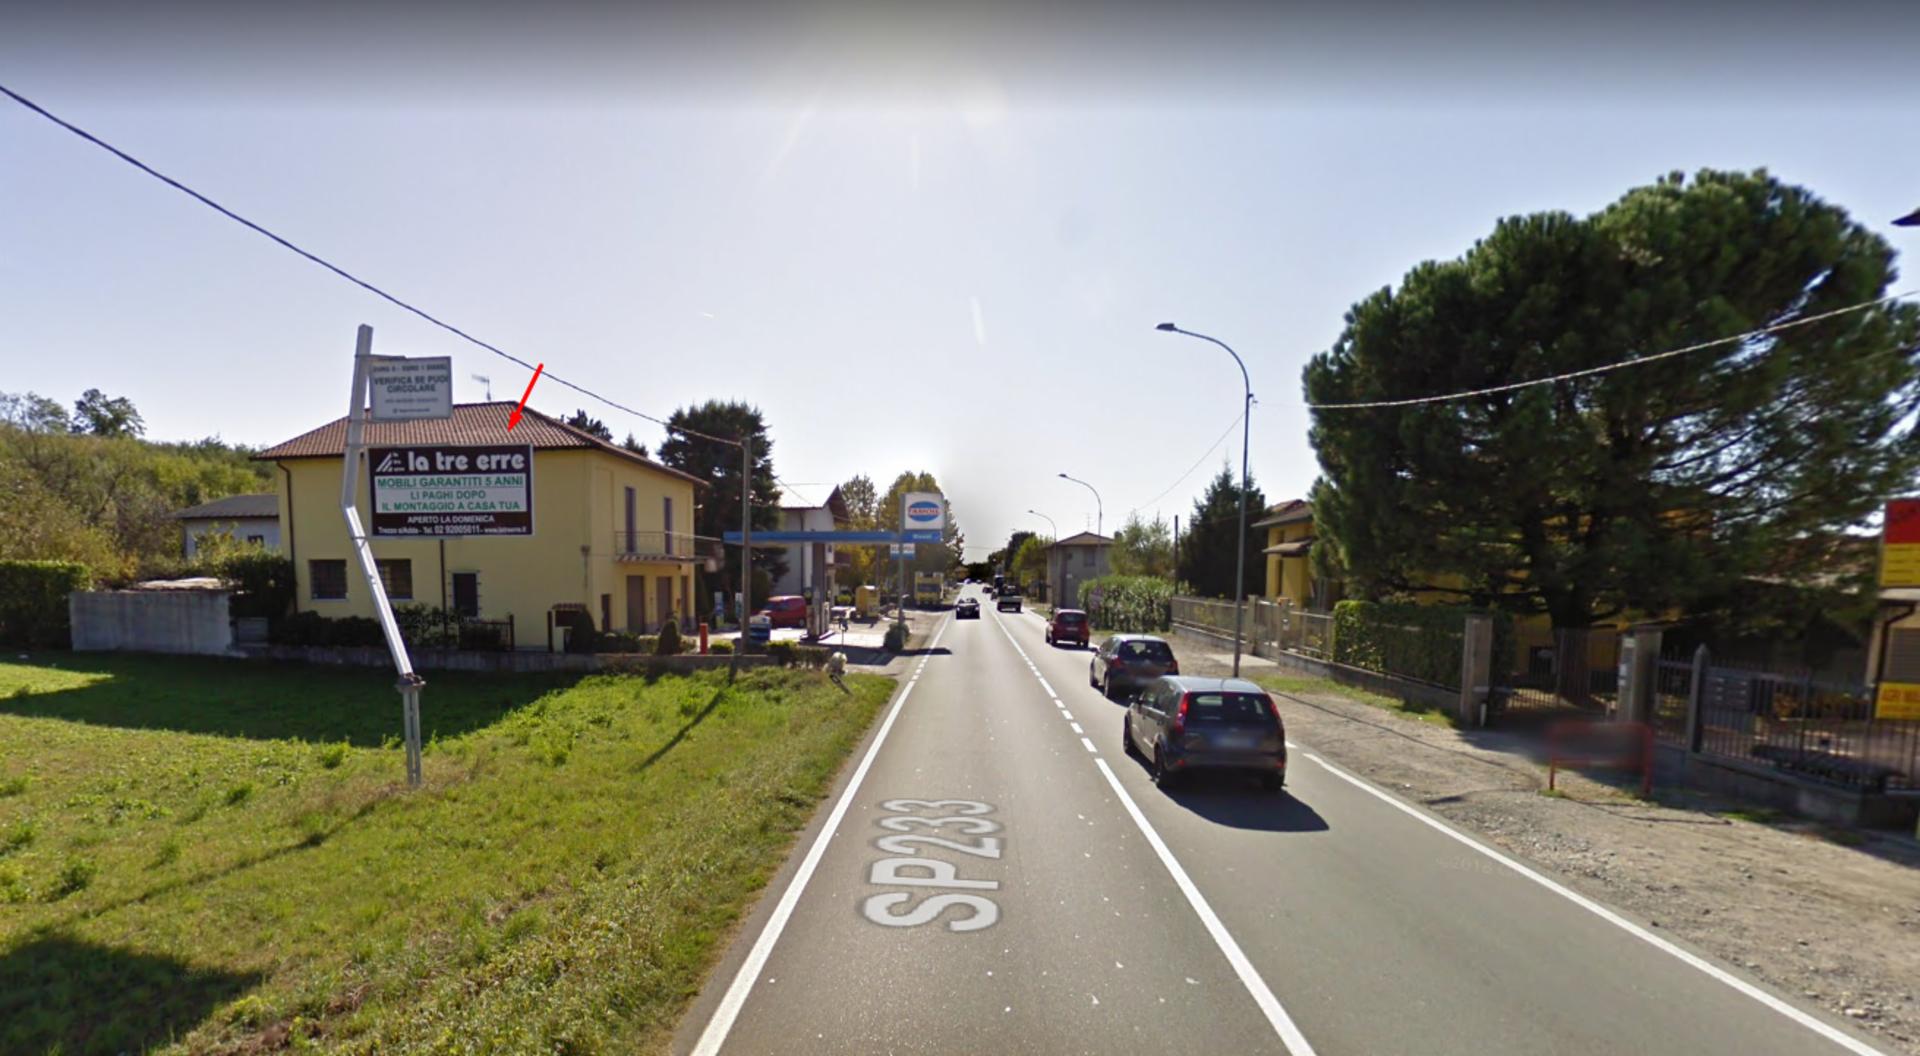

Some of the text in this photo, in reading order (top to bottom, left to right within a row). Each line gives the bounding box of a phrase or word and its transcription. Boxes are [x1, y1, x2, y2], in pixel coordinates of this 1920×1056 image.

[374, 375, 412, 385] VERIFICA
[414, 375, 426, 384] SE
[386, 384, 436, 393] CIRCOLARE
[408, 450, 429, 471] la
[436, 451, 469, 471] tre
[476, 453, 525, 471] erre
[378, 475, 523, 488] MOBILI GARANTITI 5 ANNI
[410, 489, 486, 500] LI PAGHI DOPO
[382, 501, 520, 511] IL MONTAGGIO A CASA TUA
[407, 514, 495, 524] APERTO LA DOMENICA
